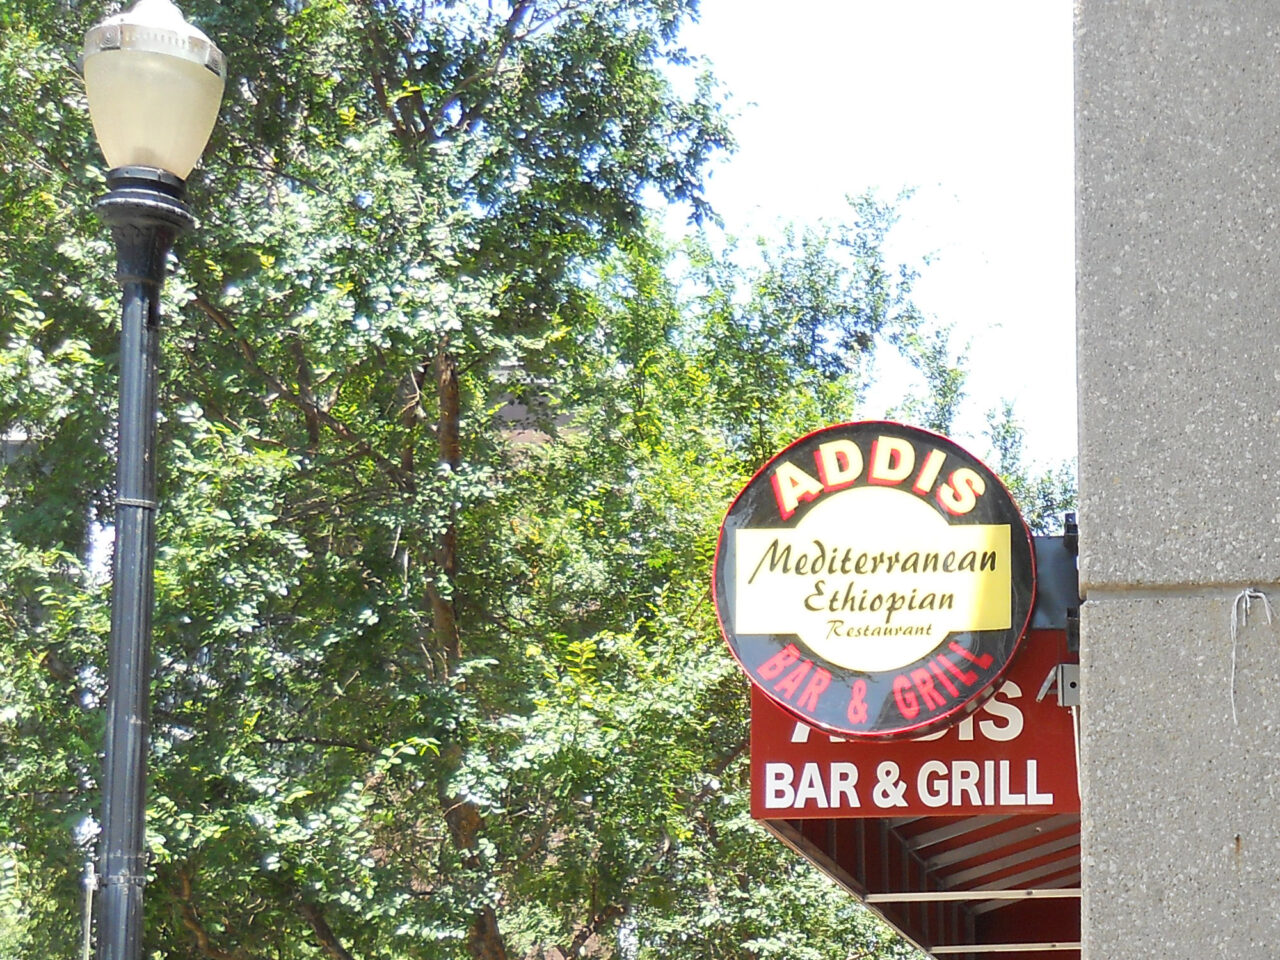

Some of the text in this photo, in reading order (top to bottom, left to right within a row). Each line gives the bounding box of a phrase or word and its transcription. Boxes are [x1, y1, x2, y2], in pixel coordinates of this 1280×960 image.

[771, 435, 986, 519] ADDIS
[748, 538, 997, 585] Mediterranean
[804, 581, 954, 624] Ethiopian
[826, 620, 933, 640] Restaurant
[756, 642, 833, 714] BAR
[847, 679, 868, 724] &
[892, 641, 995, 719] GRILL
[765, 760, 1054, 809] BAR & GRILL
